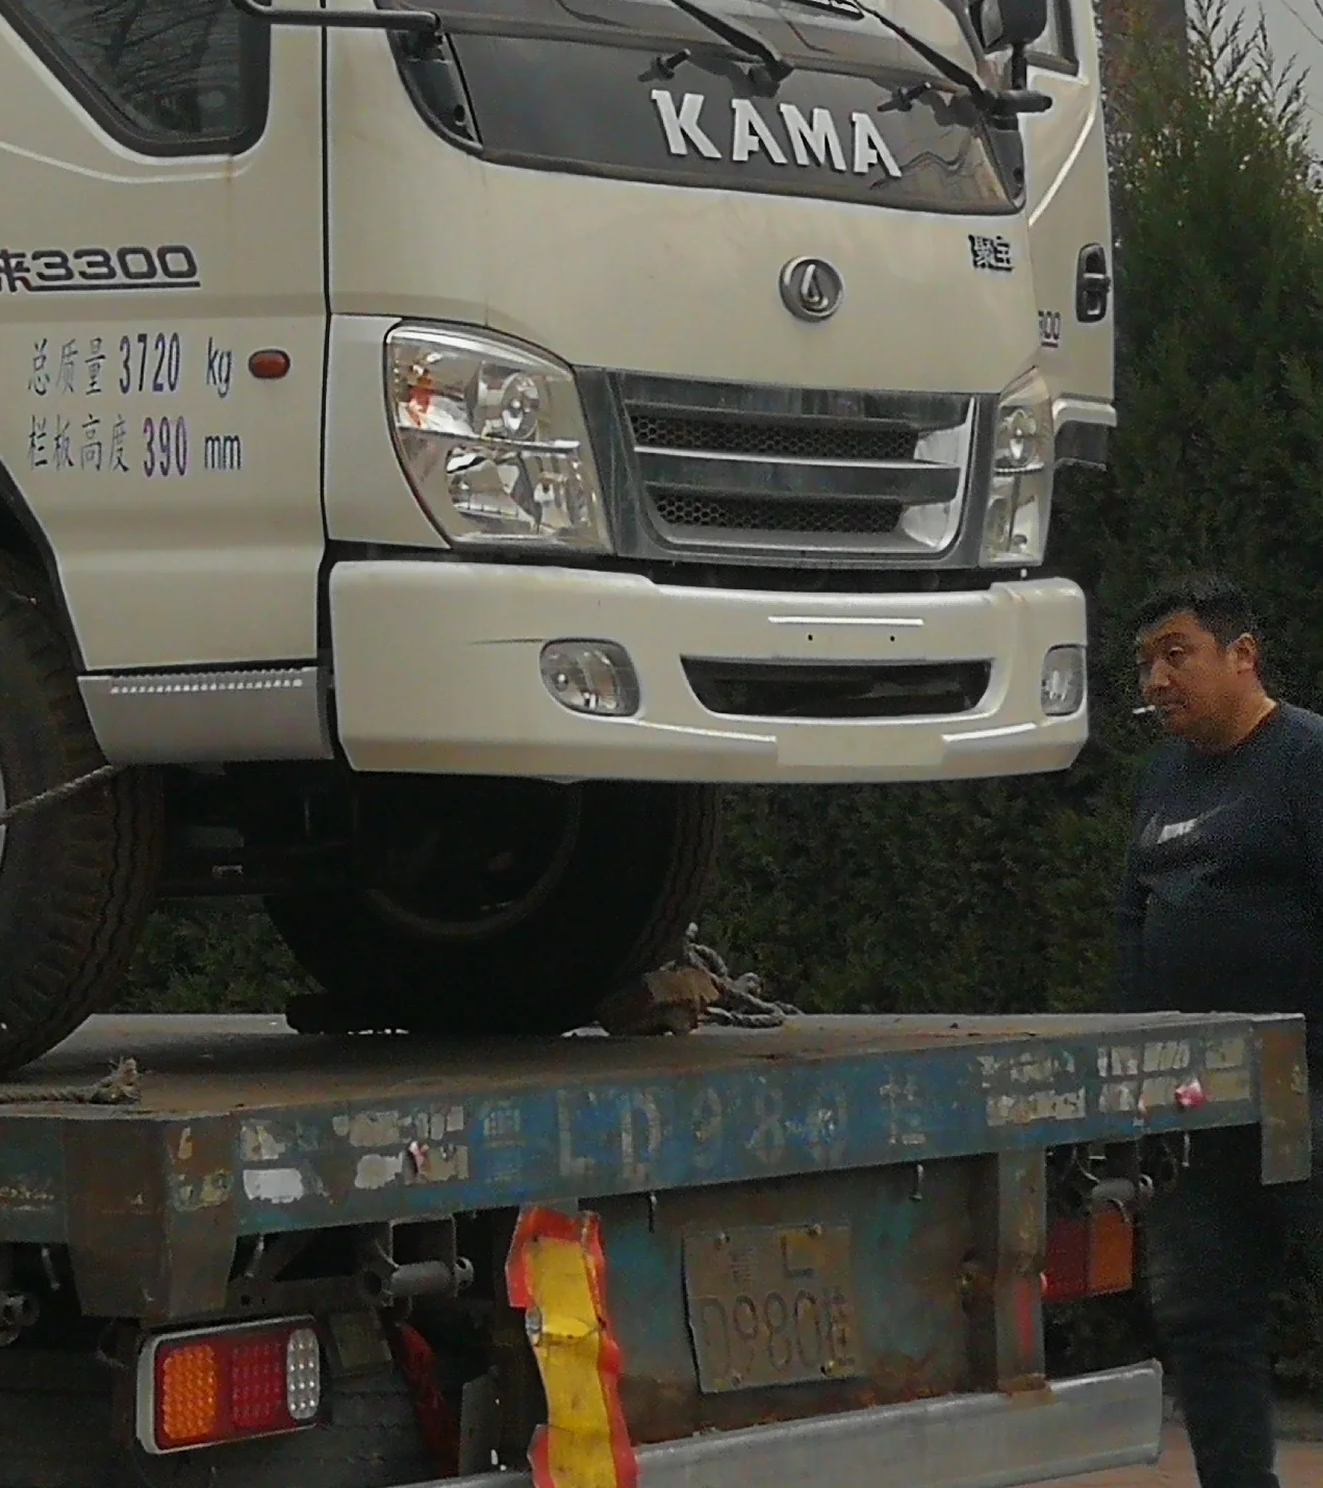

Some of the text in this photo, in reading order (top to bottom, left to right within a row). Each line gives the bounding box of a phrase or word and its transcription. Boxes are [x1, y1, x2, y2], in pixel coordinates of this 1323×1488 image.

[651, 89, 903, 179] KAMA
[27, 332, 234, 399] 总质量 3720 kg
[27, 413, 242, 478] 栏板高度 390 mm
